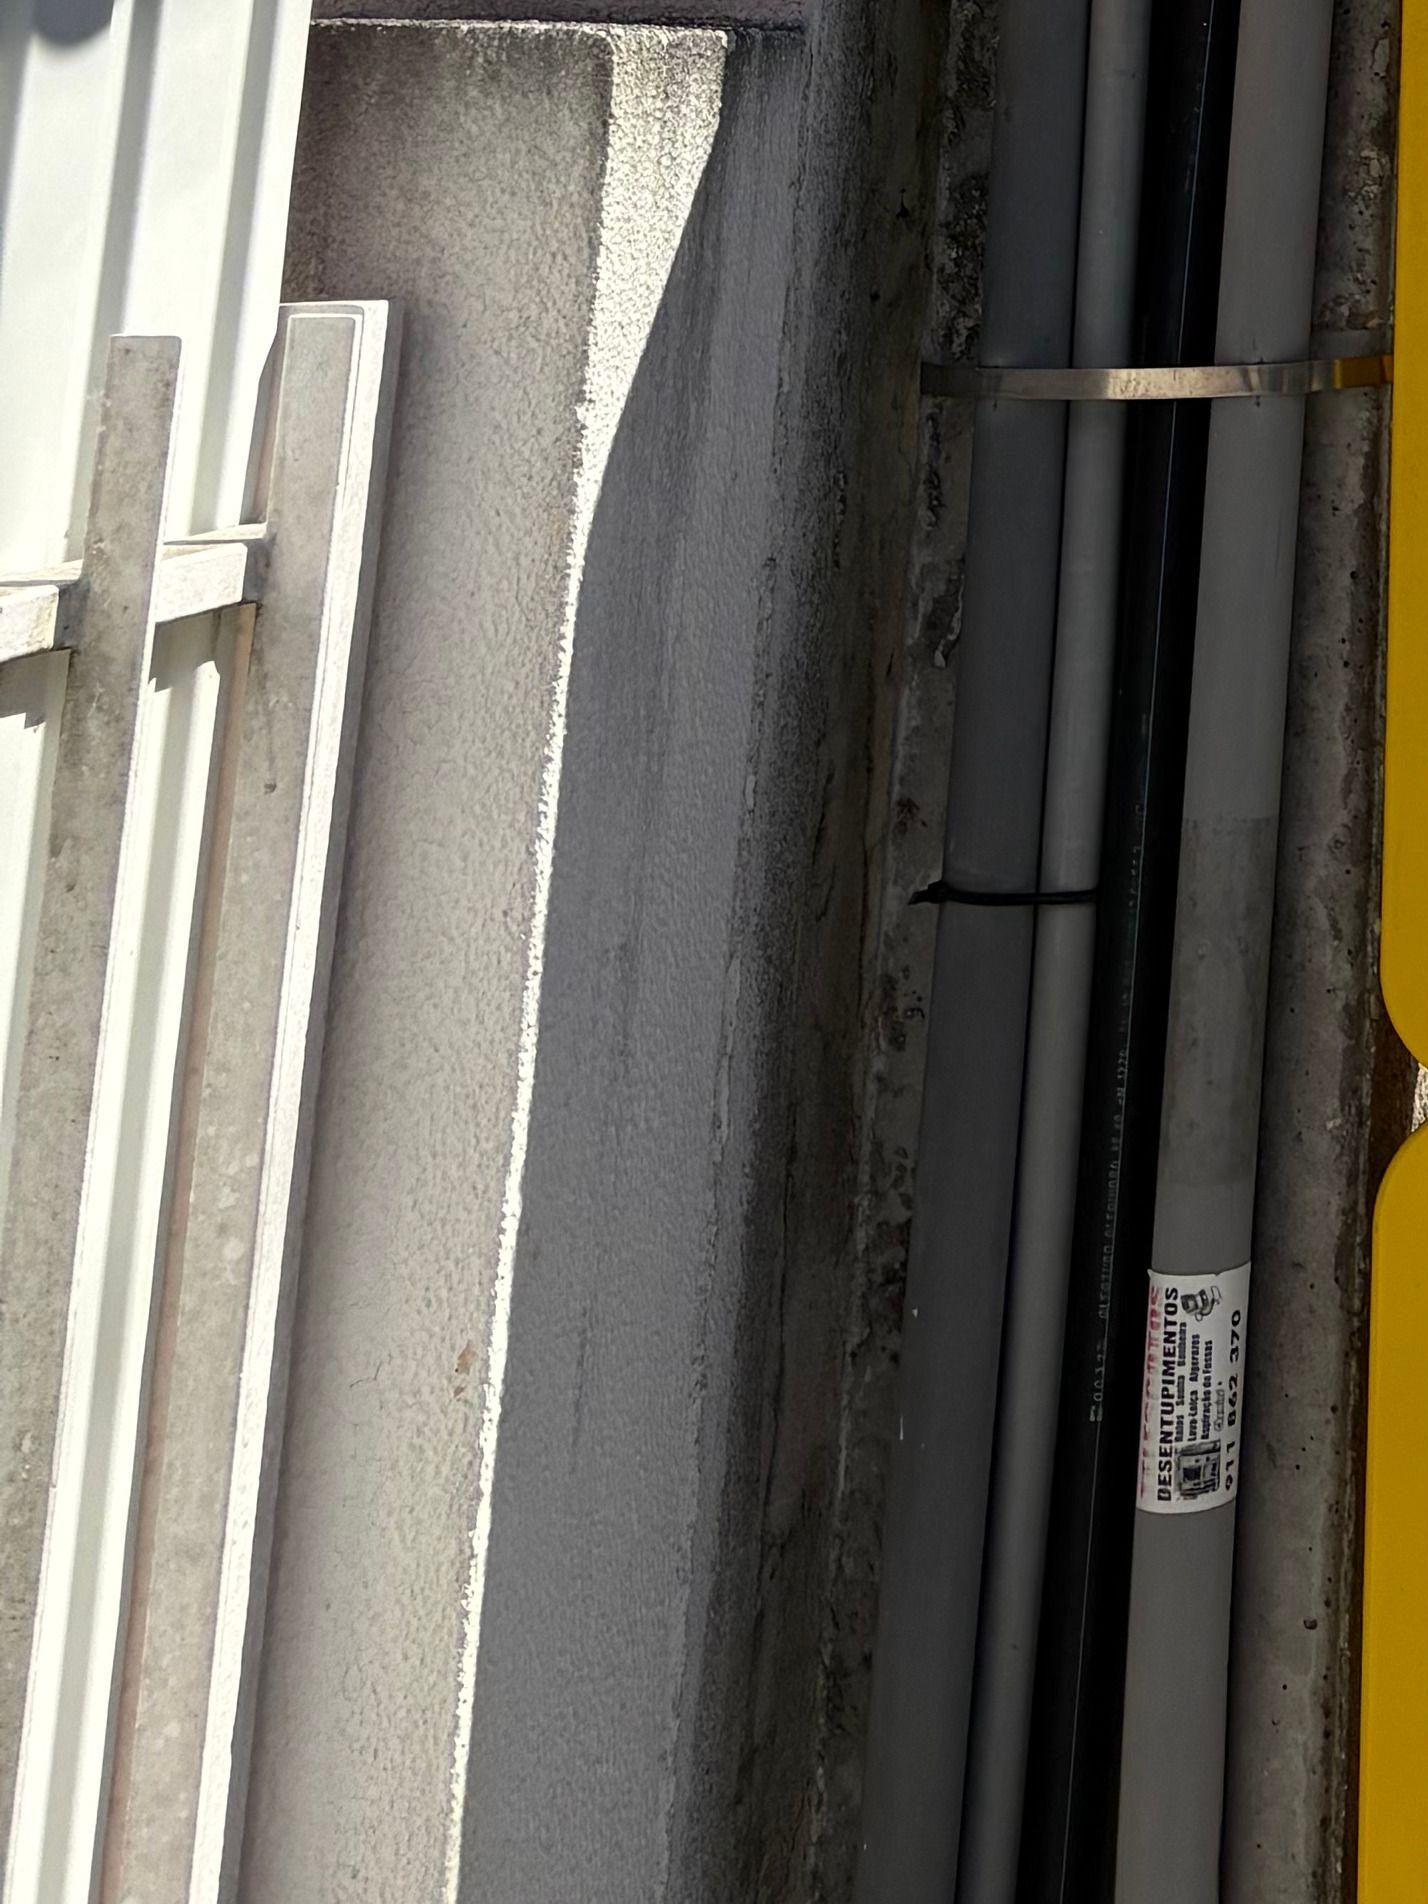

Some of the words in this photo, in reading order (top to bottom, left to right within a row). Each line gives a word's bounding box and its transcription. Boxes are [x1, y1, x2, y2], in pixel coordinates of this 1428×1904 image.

[1229, 1310, 1241, 1362] 370
[1157, 1287, 1178, 1501] DESENTUPIMENTOS
[1224, 1441, 1236, 1490] 911
